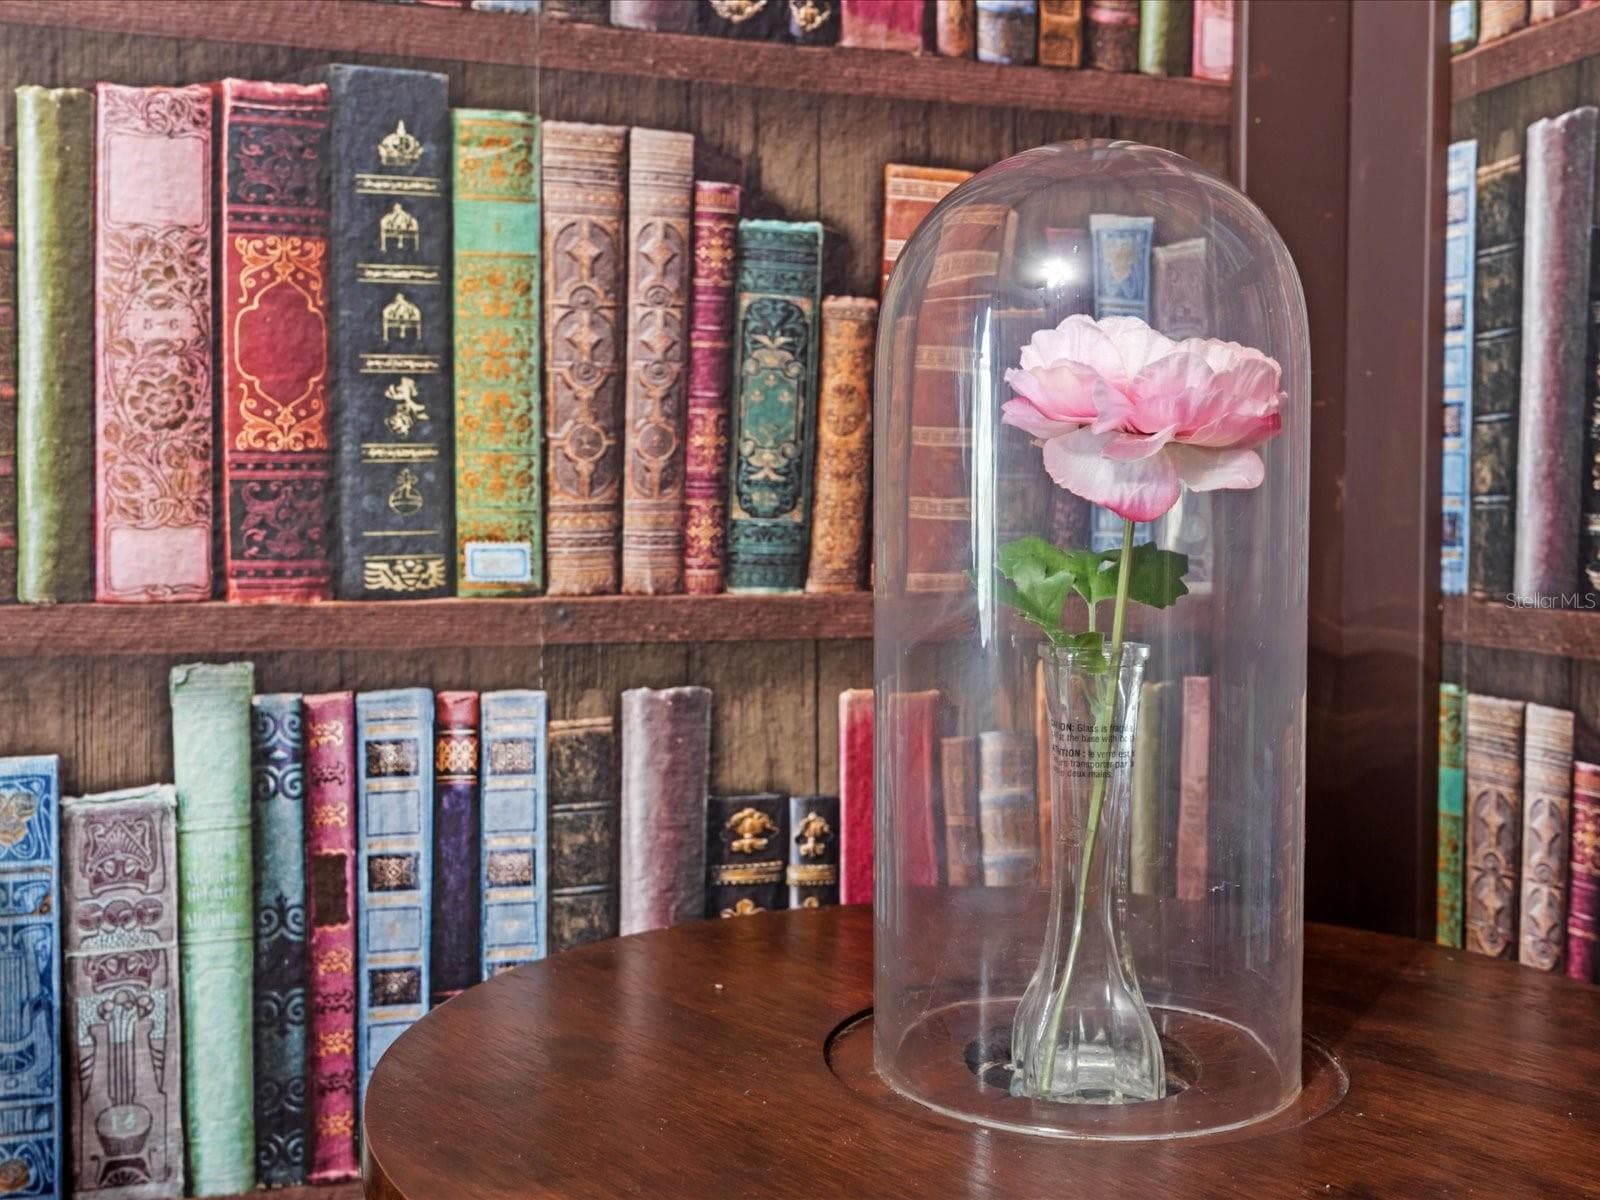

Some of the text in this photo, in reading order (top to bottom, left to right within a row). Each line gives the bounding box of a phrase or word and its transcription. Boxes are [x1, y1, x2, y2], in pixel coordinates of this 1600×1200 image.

[1077, 724, 1099, 733] Glass
[1101, 725, 1108, 733] is
[1067, 734, 1080, 742] the
[1067, 769, 1086, 778] deux
